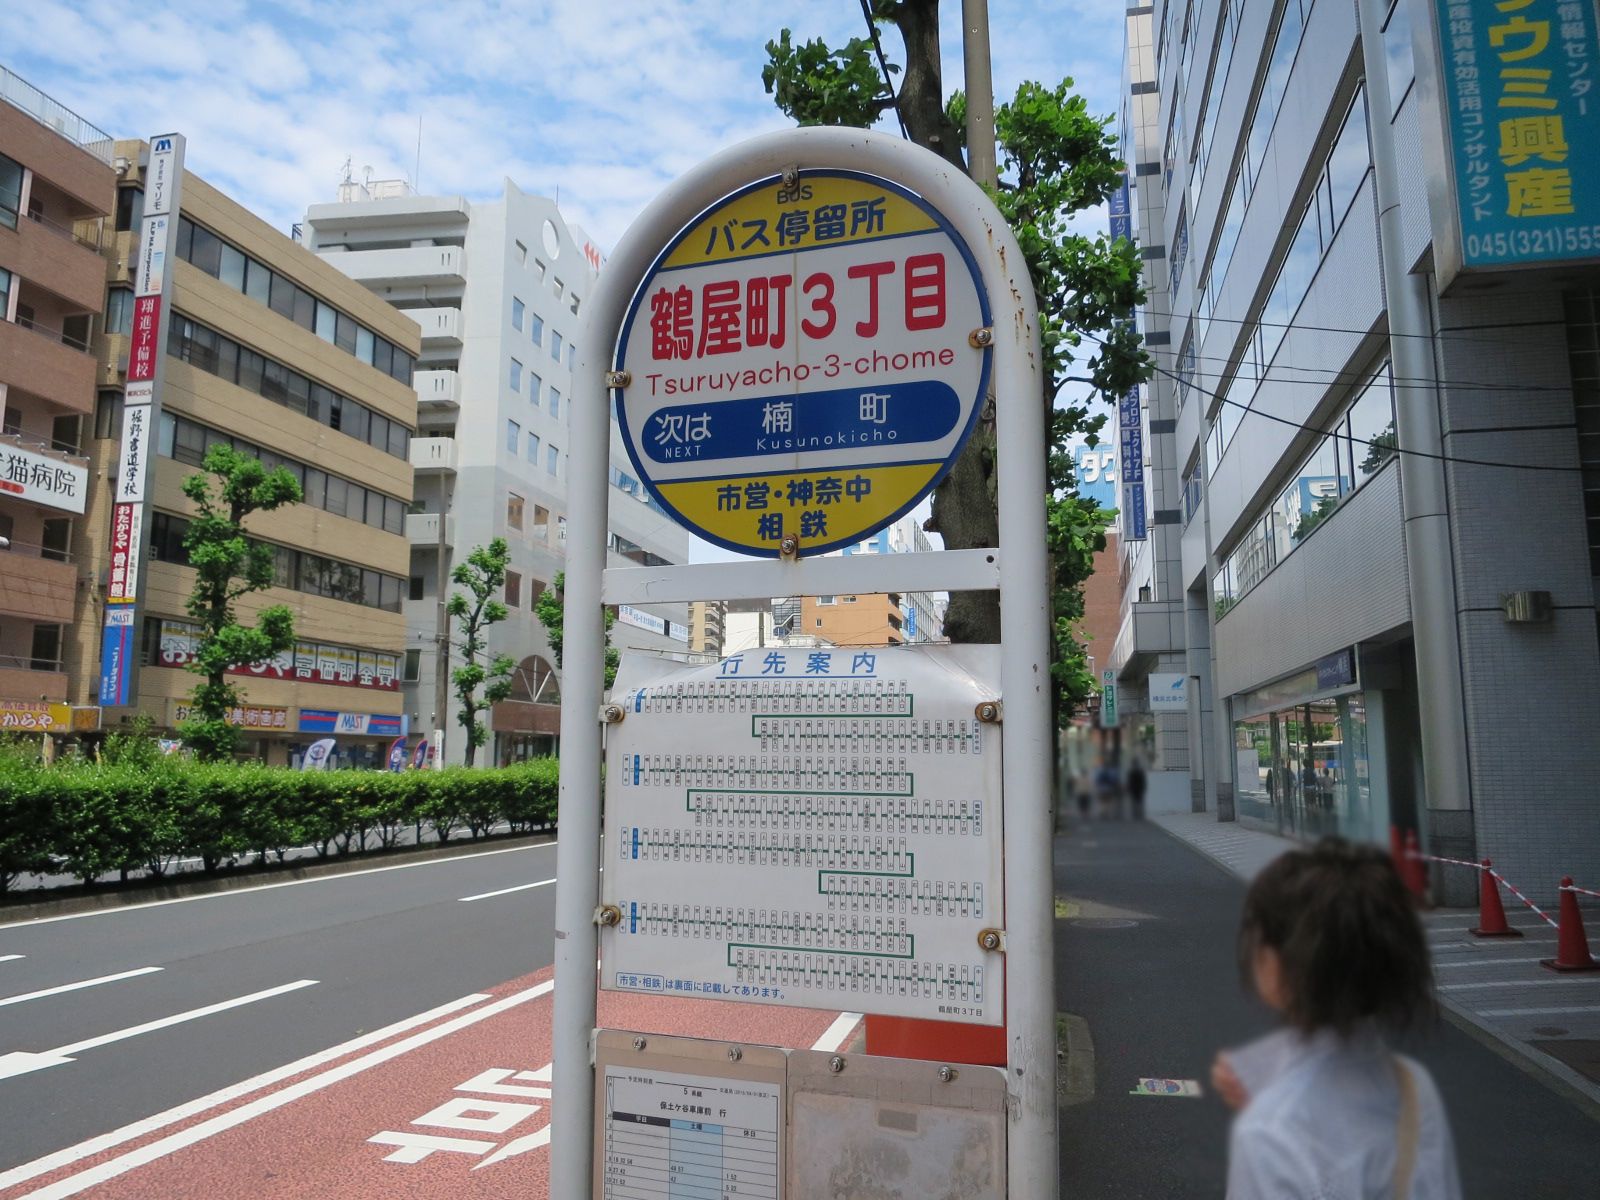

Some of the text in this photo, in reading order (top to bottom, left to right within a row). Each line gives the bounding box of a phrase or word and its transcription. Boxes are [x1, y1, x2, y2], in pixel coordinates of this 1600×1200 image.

[1557, 0, 1591, 115] 情報センター
[1447, 0, 1493, 221] 産投資有効活用コンサルタント
[152, 182, 164, 210] マリモ
[705, 197, 886, 256] バス停留所
[649, 252, 946, 360] 鶴屋町3丁目
[135, 298, 154, 378] 翔進予備校
[646, 347, 955, 396] Tsuruyacho-3-chome
[654, 411, 712, 444] 次は
[756, 428, 897, 451] Kusunokicho
[665, 444, 702, 459] NEXT
[0, 452, 76, 497] 猫病院
[716, 474, 872, 512] 市営・神奈中
[757, 509, 828, 540] 相鉄
[720, 651, 877, 674] 行先案内
[341, 714, 364, 729] MAST
[683, 1088, 688, 1096] 5
[636, 1115, 648, 1123] 平日
[691, 1123, 703, 1131] 土曜
[719, 1109, 727, 1118] 行
[743, 1130, 756, 1138] 休日
